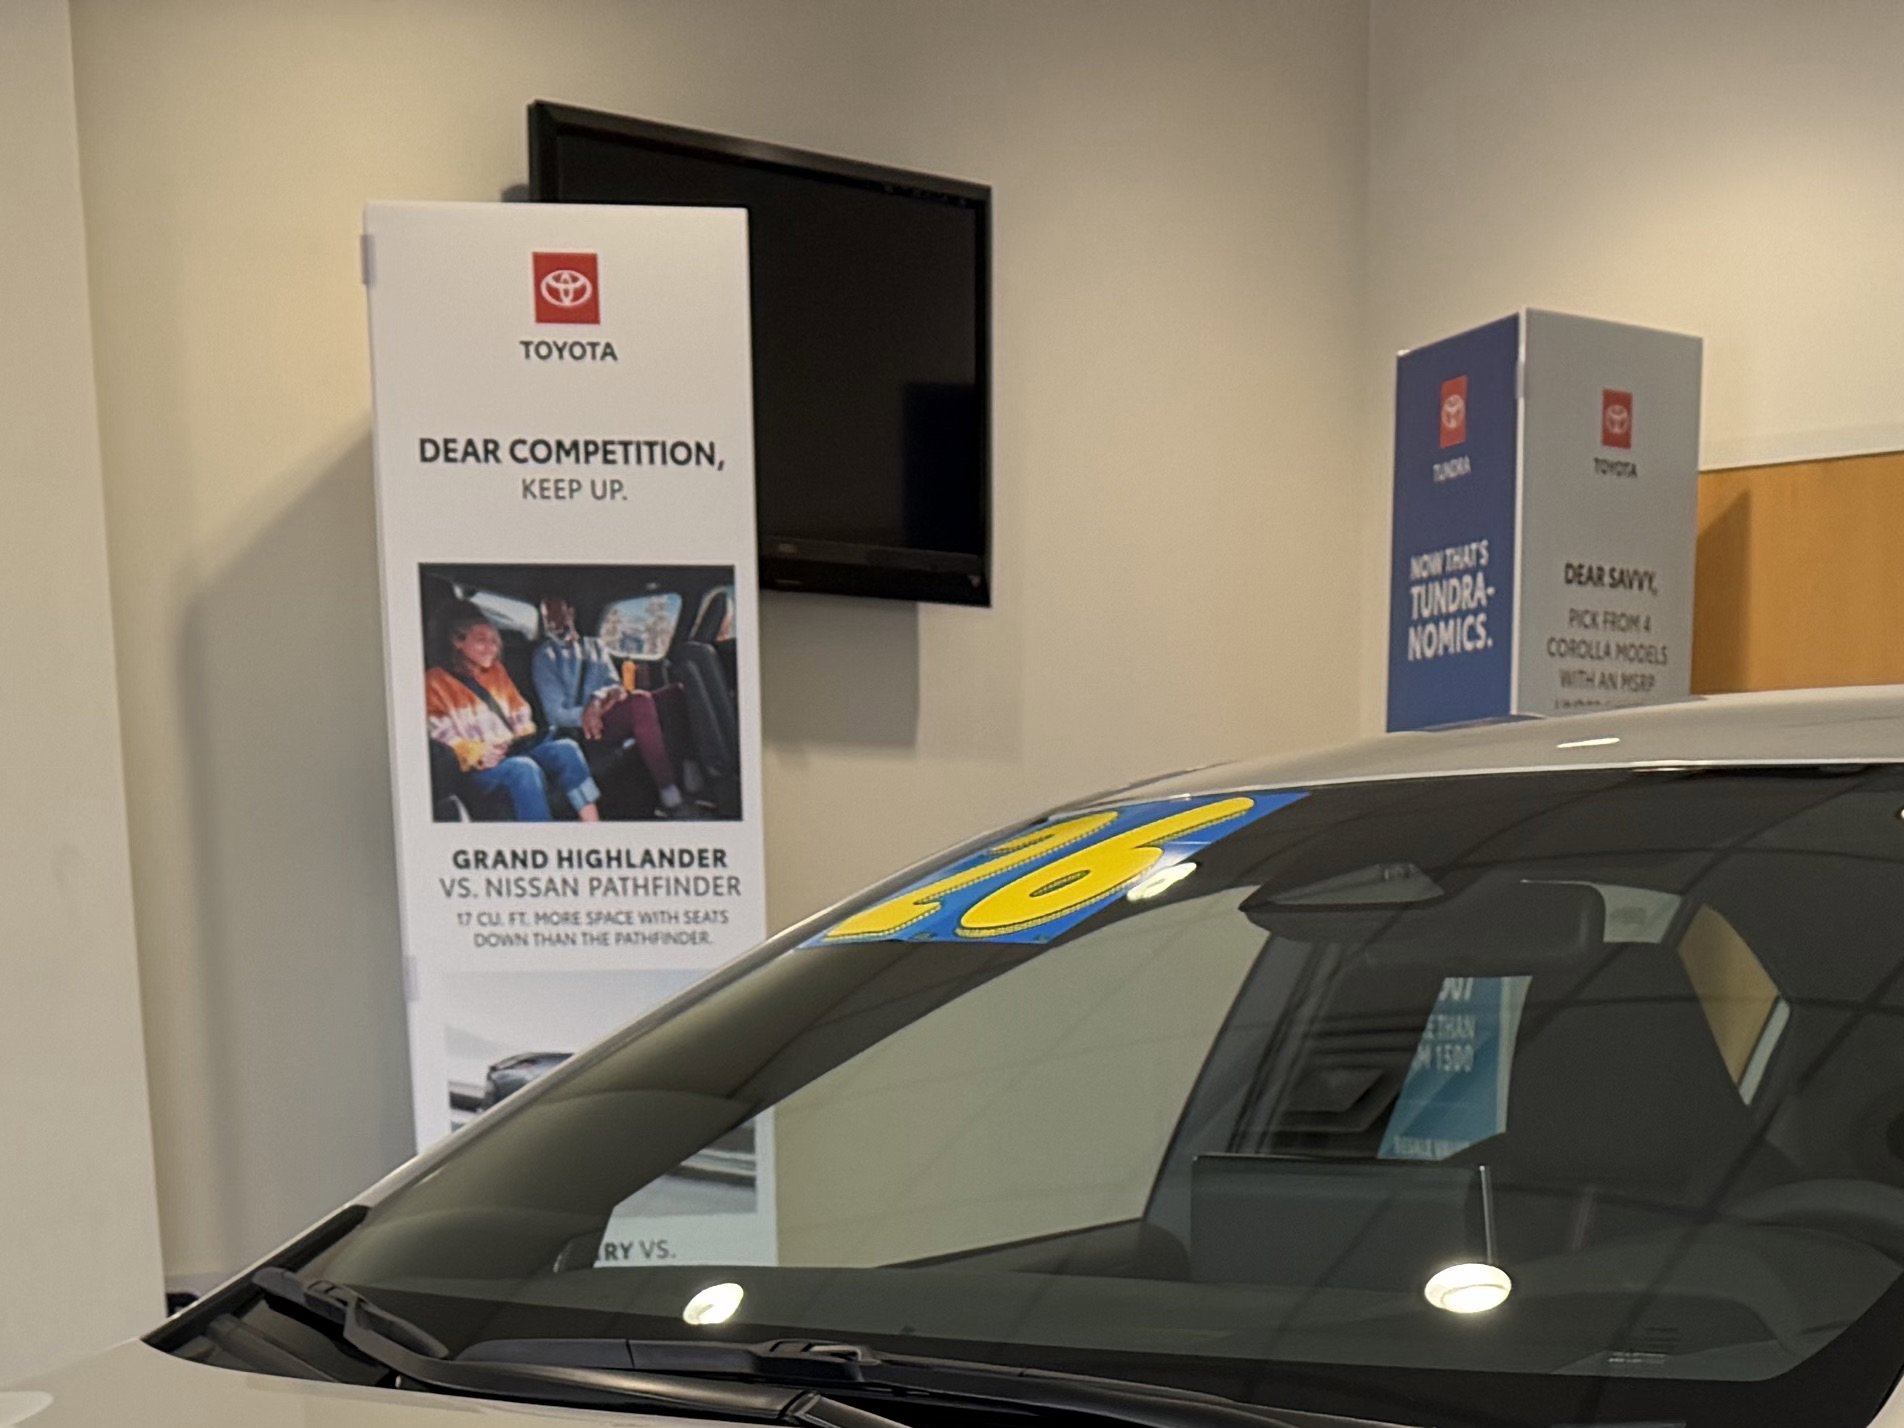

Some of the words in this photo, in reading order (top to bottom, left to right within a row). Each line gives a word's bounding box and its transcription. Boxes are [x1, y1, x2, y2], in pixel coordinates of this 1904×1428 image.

[519, 340, 618, 362] TOYOTA
[418, 437, 501, 465] DEAR
[508, 439, 725, 471] COMPETITION,
[1594, 456, 1639, 479] TOYOTA
[521, 478, 582, 501] KEEP
[590, 478, 628, 501] UP.
[1410, 552, 1443, 580] NOW
[1445, 539, 1489, 572] THAT'S
[1564, 562, 1605, 588] DEAR
[1609, 566, 1658, 596] SAVVY,
[1410, 571, 1495, 620] TUNDRA-
[1568, 608, 1599, 631] PICK
[1603, 610, 1641, 633] FROM
[1407, 612, 1493, 661] NOMICS.
[1546, 636, 1611, 661] COROLLA
[1615, 642, 1668, 666] MODELS
[1560, 669, 1595, 689] WITH
[1598, 671, 1618, 691] AN
[1621, 672, 1655, 693] MSRP
[452, 848, 549, 870] GRAND
[556, 847, 728, 869] HIGHLANDER
[439, 877, 479, 900] VS.
[485, 876, 580, 899] NISSAN
[589, 875, 742, 897] PATHFINDER
[457, 912, 472, 927] 17
[534, 911, 580, 926] MORE
[586, 911, 634, 925] SPACE
[638, 910, 679, 925] WITH
[683, 910, 729, 925] SEATS
[473, 932, 529, 948] DOWN
[533, 932, 577, 947] THAN
[581, 932, 609, 947] THE
[614, 931, 712, 947] PATHFINDER.
[598, 1241, 633, 1261] RY
[638, 1239, 677, 1260] VS.
